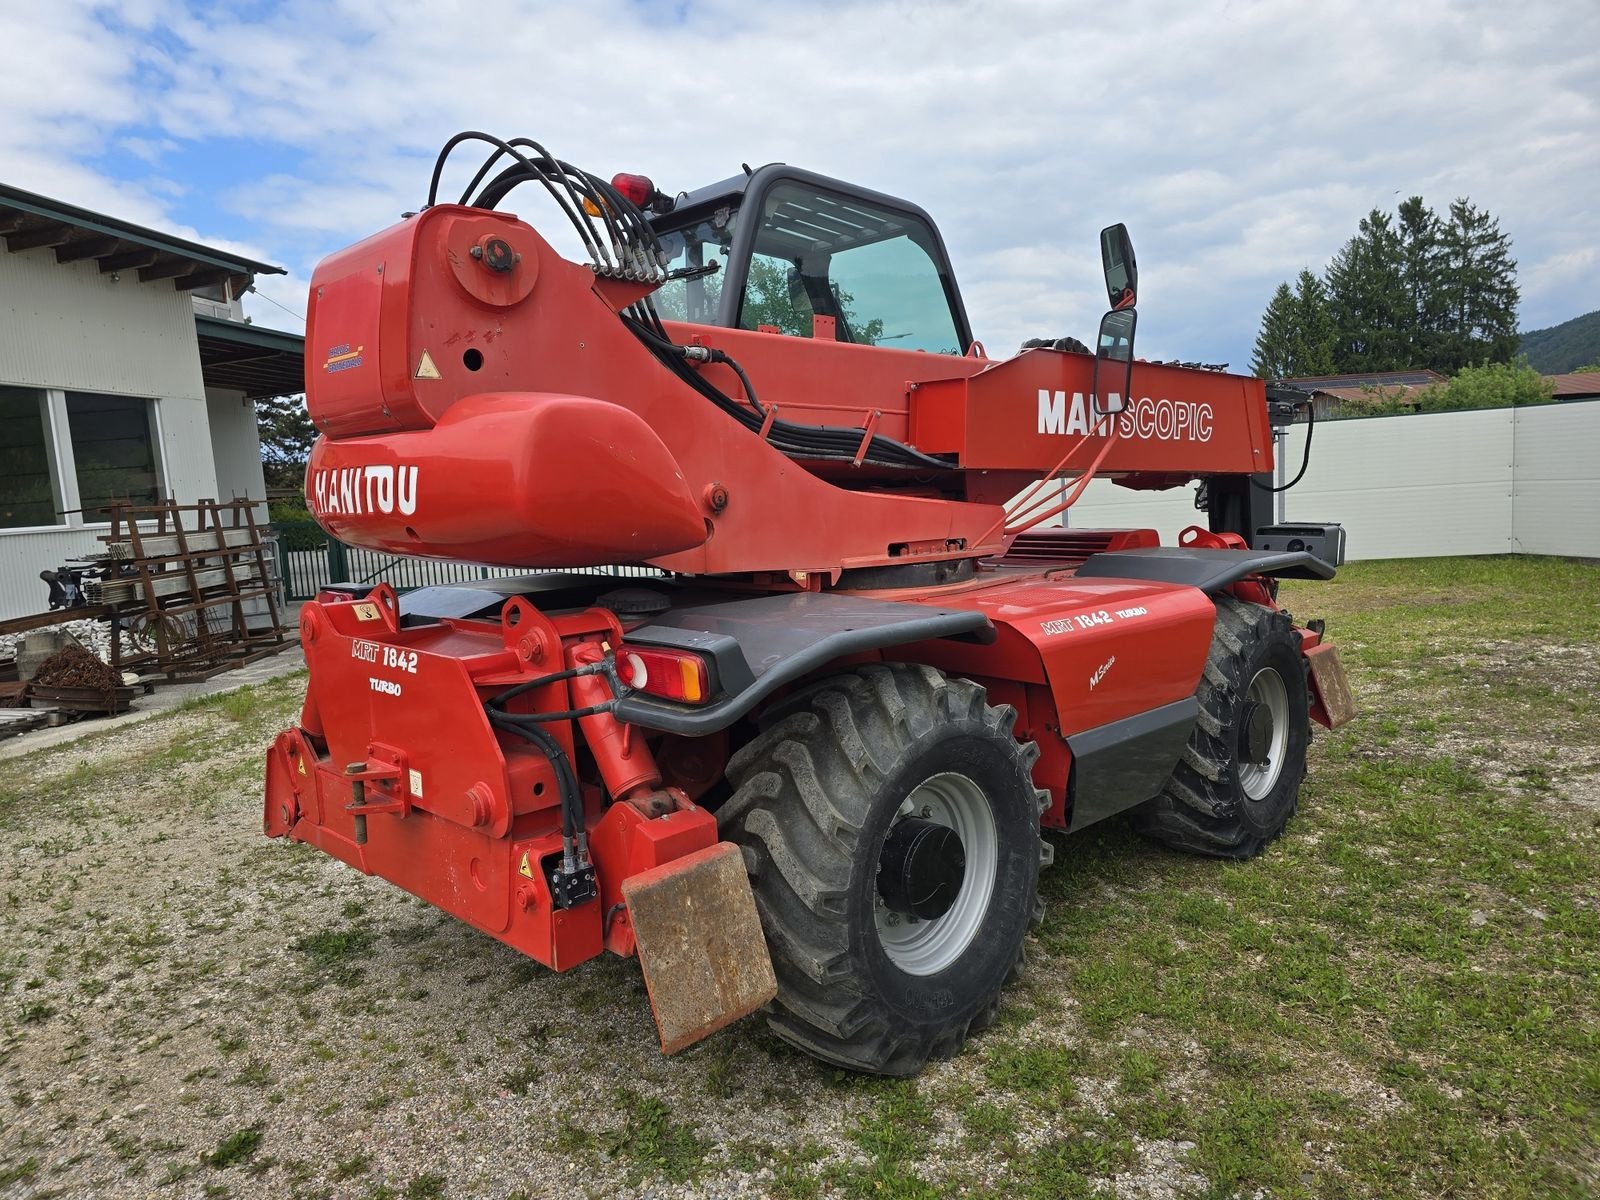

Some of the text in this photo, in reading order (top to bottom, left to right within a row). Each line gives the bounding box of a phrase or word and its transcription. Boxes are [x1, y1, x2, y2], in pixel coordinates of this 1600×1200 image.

[314, 464, 418, 515] MANITOU
[1040, 606, 1148, 635] MRT 1842 TURBO
[351, 639, 418, 674] MRT 1842
[369, 677, 402, 697] TURBO
